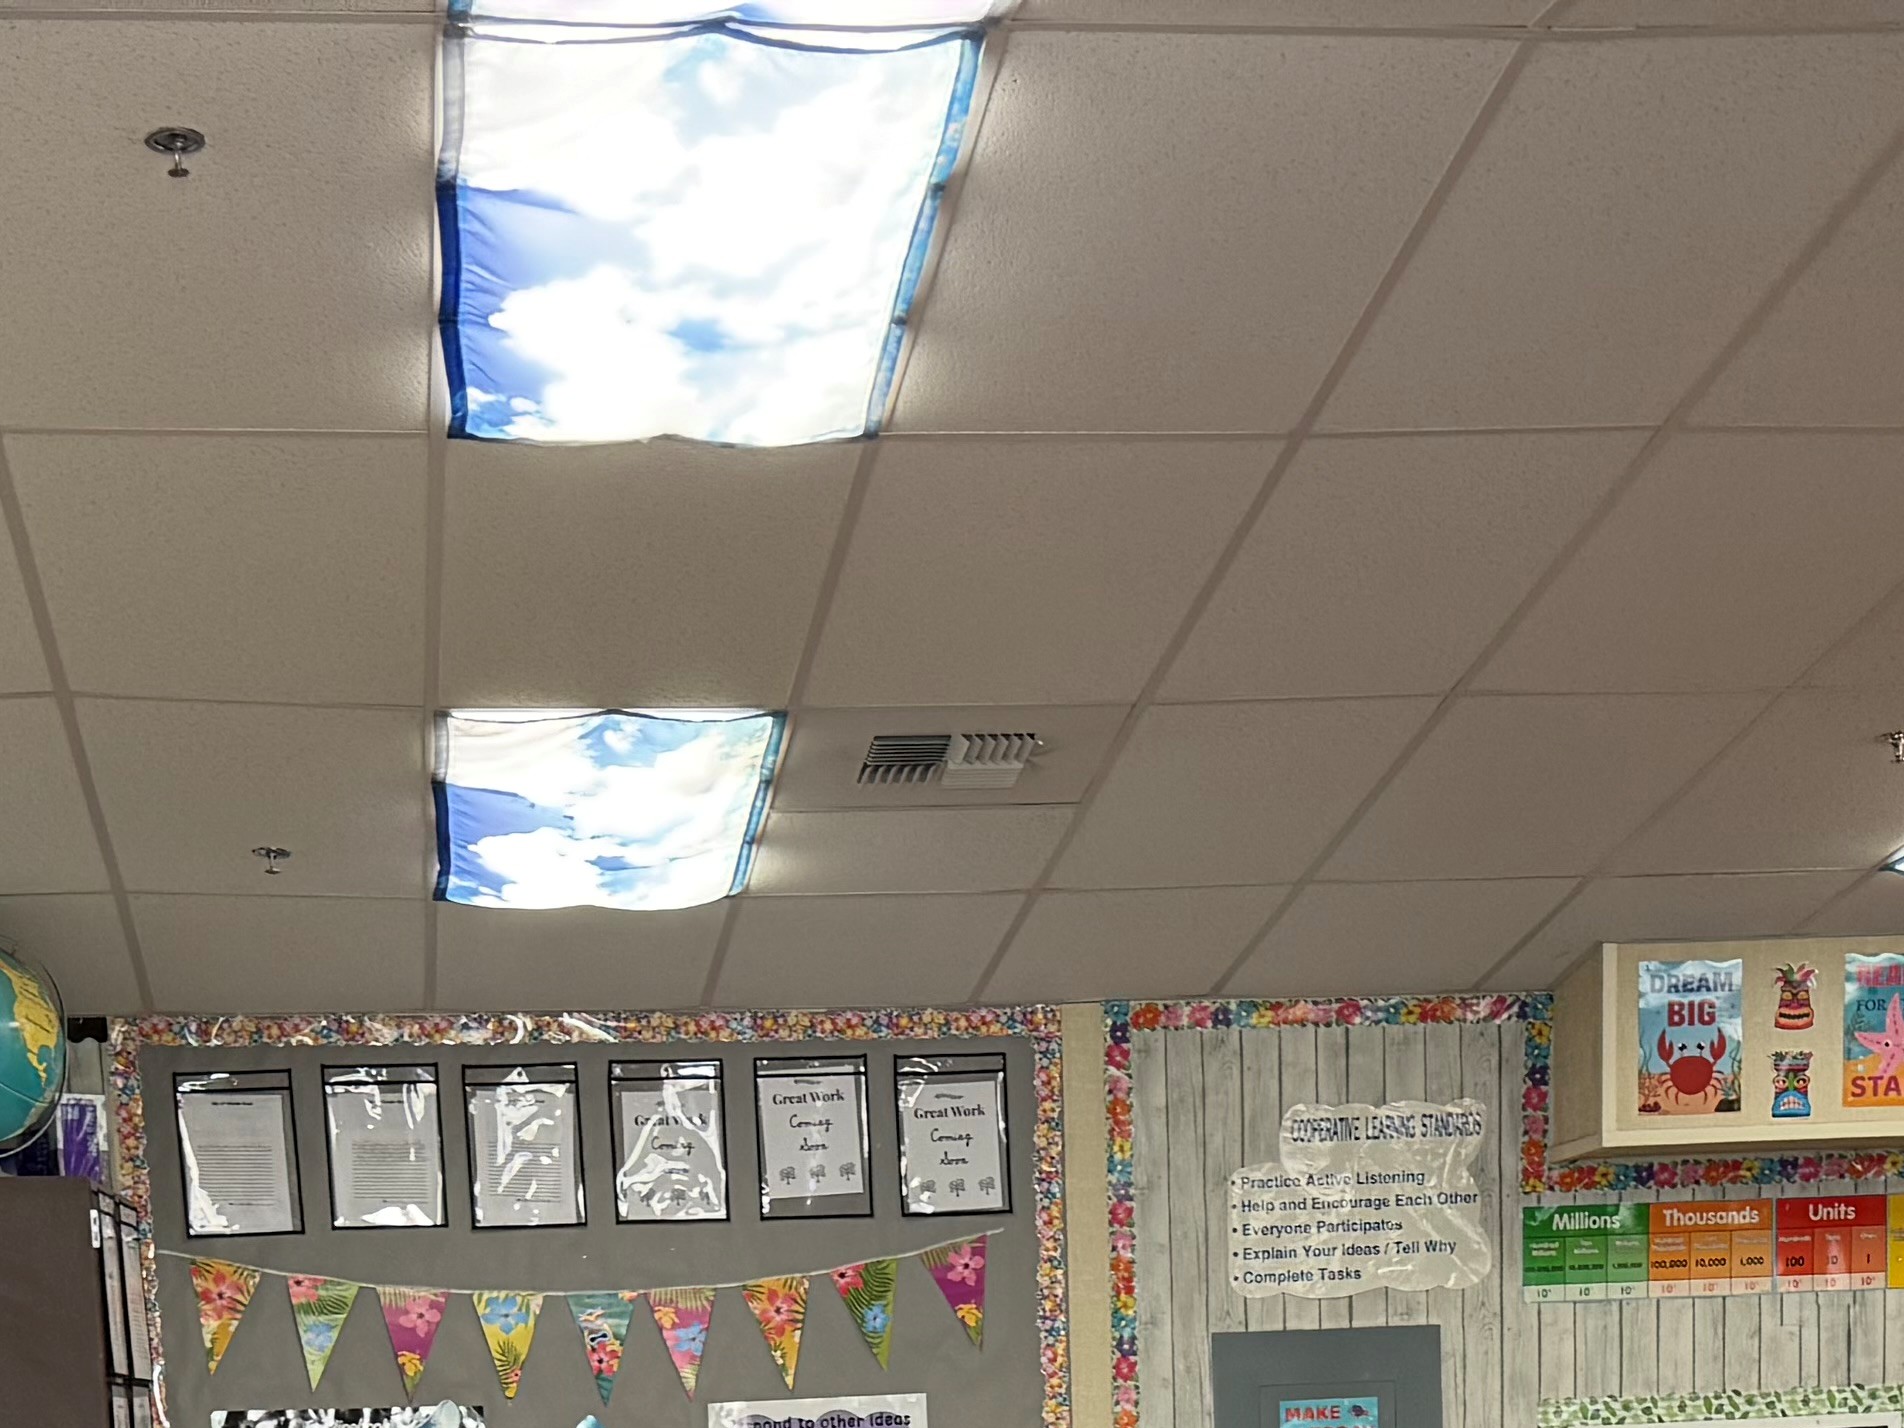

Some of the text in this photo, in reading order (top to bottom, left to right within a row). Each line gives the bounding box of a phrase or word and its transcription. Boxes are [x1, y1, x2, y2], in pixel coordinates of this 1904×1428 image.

[1649, 970, 1733, 994] DREAM
[1666, 998, 1717, 1028] BIG
[1856, 998, 1887, 1012] FOR
[772, 1088, 845, 1106] Great Work
[914, 1103, 987, 1120] Great Work
[1292, 1111, 1483, 1143] COOPERATIVE LEARNING STANDARDS
[1241, 1170, 1426, 1190] Practice Active Listening
[1241, 1191, 1479, 1216] Help and Encourage Each Other
[1808, 1202, 1856, 1221] Units
[1552, 1211, 1621, 1231] Millions
[1662, 1205, 1760, 1227] Thousands
[1242, 1219, 1404, 1238] Everyone Participates
[1243, 1246, 1297, 1262] Explain
[1302, 1244, 1338, 1258] Your
[1342, 1243, 1381, 1257] Ideas
[1394, 1241, 1420, 1254] Tell
[1424, 1239, 1457, 1255] Why
[1785, 1255, 1805, 1268] 100
[1243, 1267, 1362, 1286] Complete Tasks
[820, 1414, 865, 1428] other
[1284, 1404, 1341, 1421] MAKE
